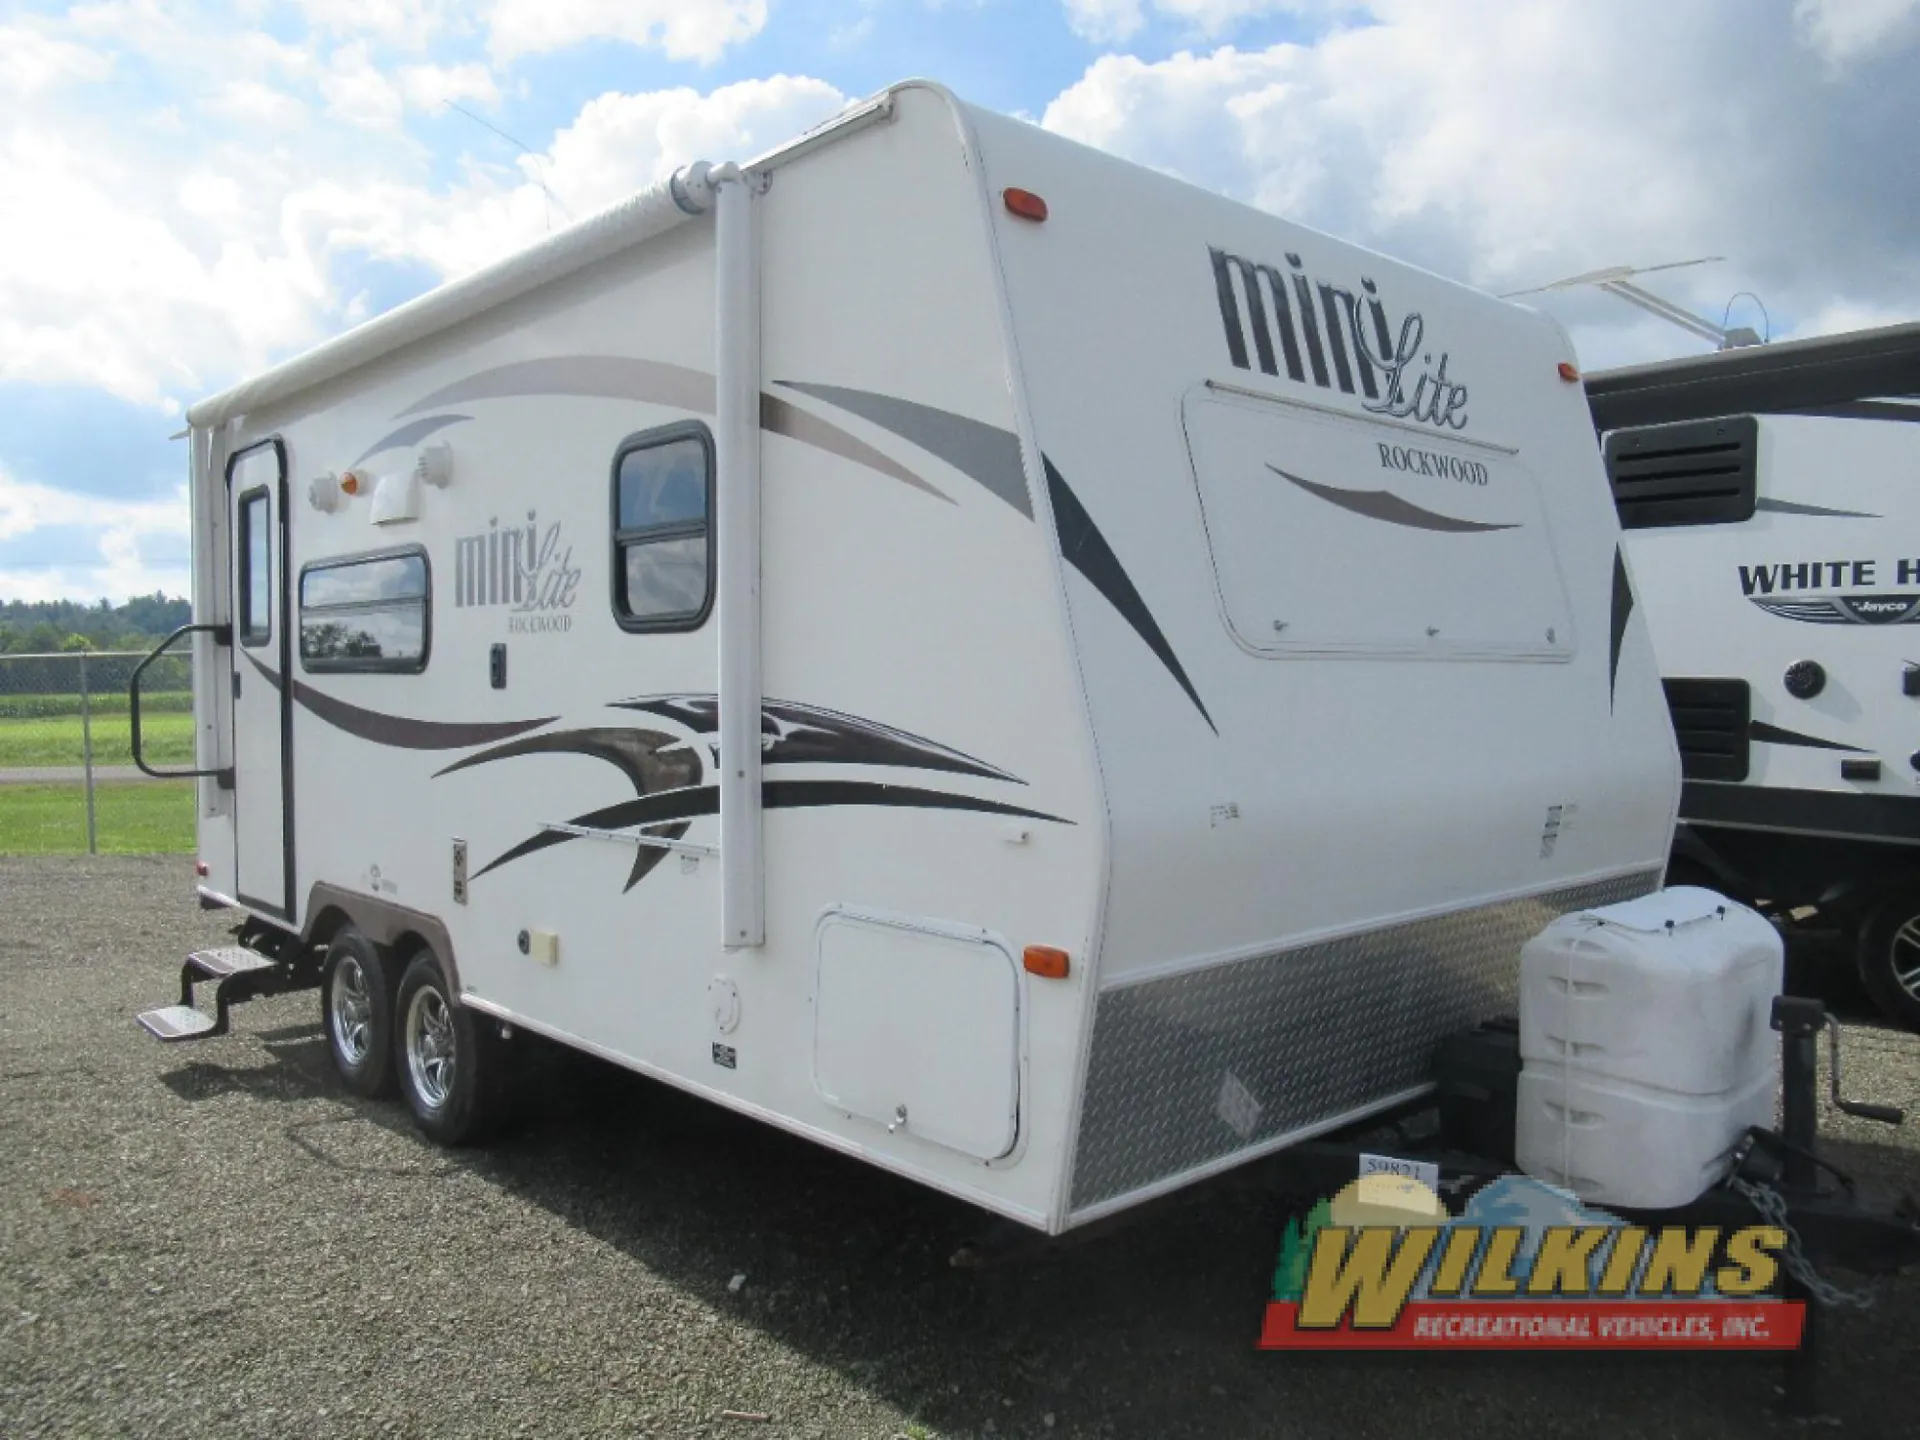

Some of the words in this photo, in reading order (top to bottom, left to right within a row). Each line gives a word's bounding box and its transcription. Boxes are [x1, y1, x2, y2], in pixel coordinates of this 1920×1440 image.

[1206, 243, 1405, 404] mini
[1377, 442, 1489, 487] ROCKWOOD
[455, 509, 537, 608] mini
[1738, 560, 1876, 595] WHITE
[508, 615, 573, 633] ROCKWOOD
[1858, 600, 1908, 613] Jayco
